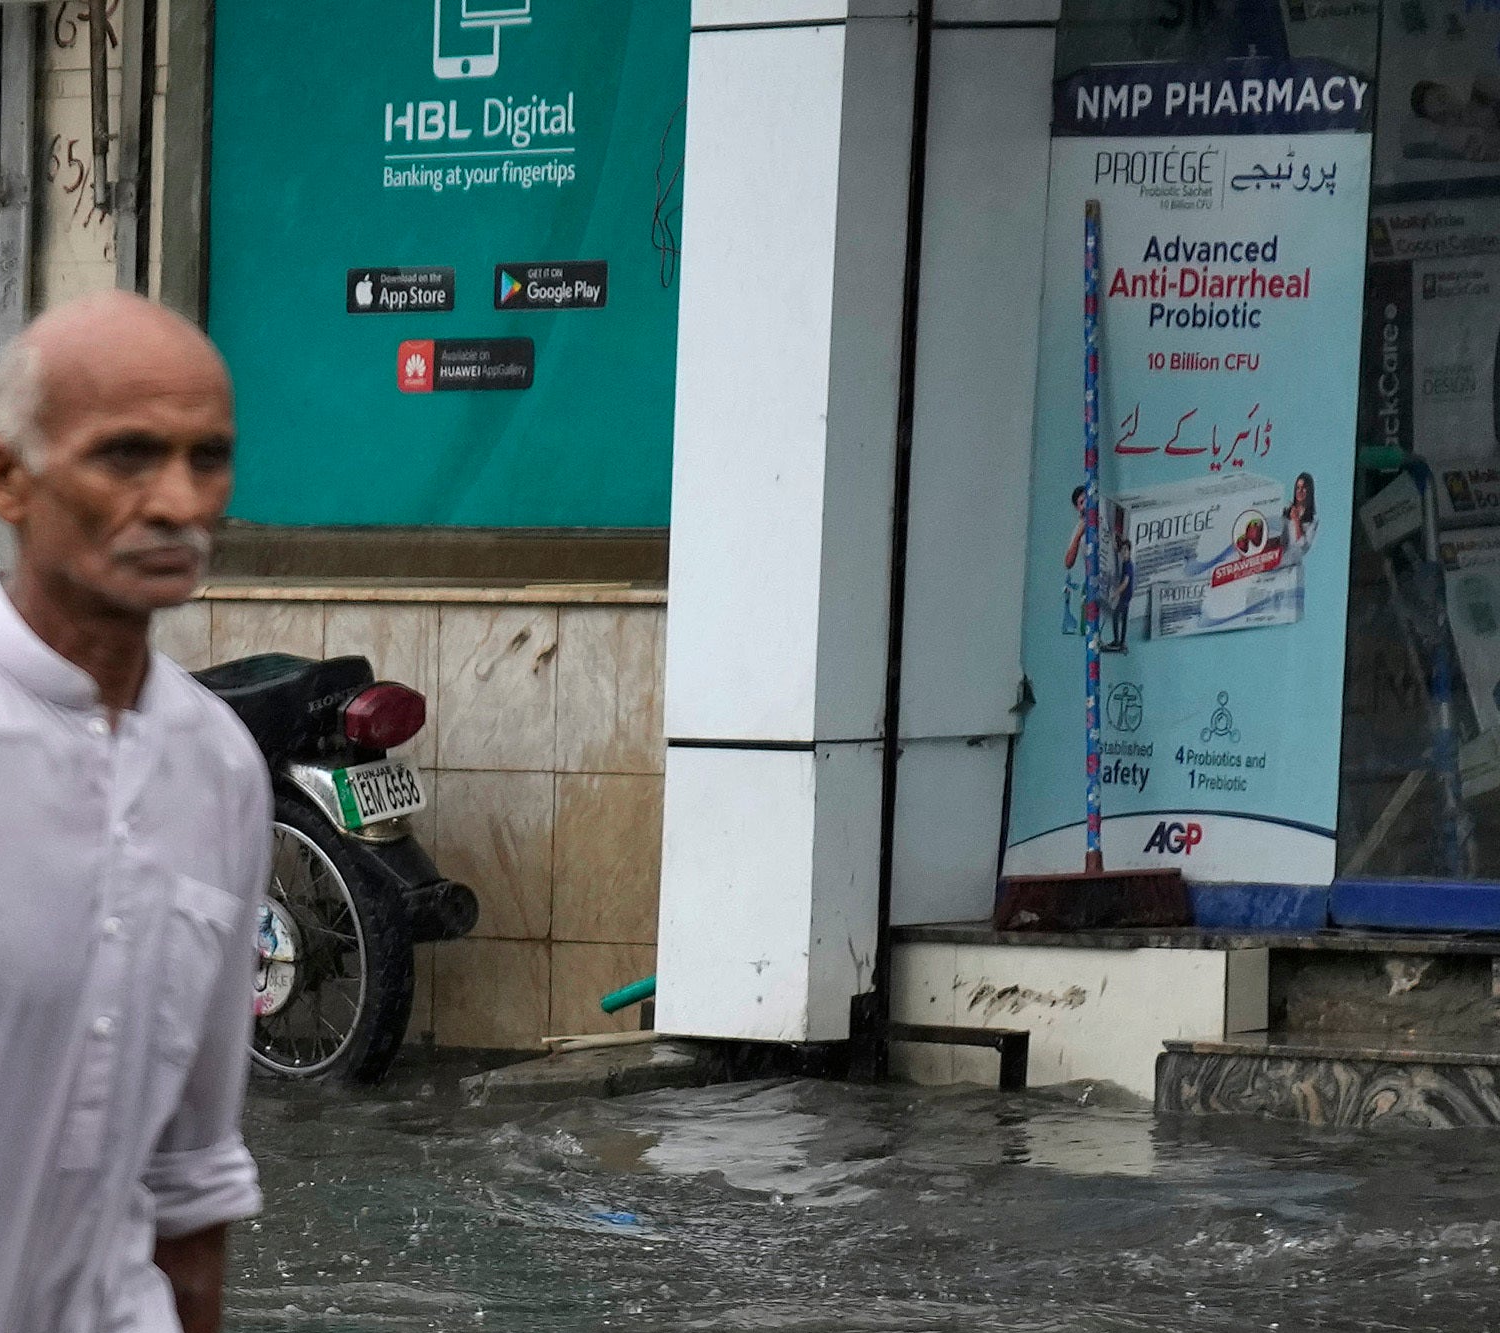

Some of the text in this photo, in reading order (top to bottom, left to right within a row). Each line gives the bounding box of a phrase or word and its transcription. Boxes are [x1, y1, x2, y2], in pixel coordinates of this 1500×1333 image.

[1076, 75, 1368, 120] NMP PHARMACY
[384, 90, 576, 148] HBL Digital
[383, 158, 576, 193] Banking at your fingertips
[1094, 143, 1220, 185] PROTÉGÉ
[1143, 234, 1278, 264] Advanced
[379, 285, 447, 311] App Store
[526, 279, 601, 305] Google Play
[1109, 265, 1311, 299] Anti-Diarrheal
[1149, 301, 1263, 329] Probiotic
[439, 364, 482, 377] HUAWEI
[1148, 352, 1260, 371] 10 Billion CFU
[1164, 407, 1208, 457] کے
[1097, 741, 1154, 757] stablished
[1174, 745, 1267, 769] 4 Probiotics and
[1102, 758, 1150, 793] afety
[1188, 769, 1248, 792] 1 Prebiotic
[353, 767, 421, 818] LEM 6558
[1142, 820, 1203, 855] AGP
